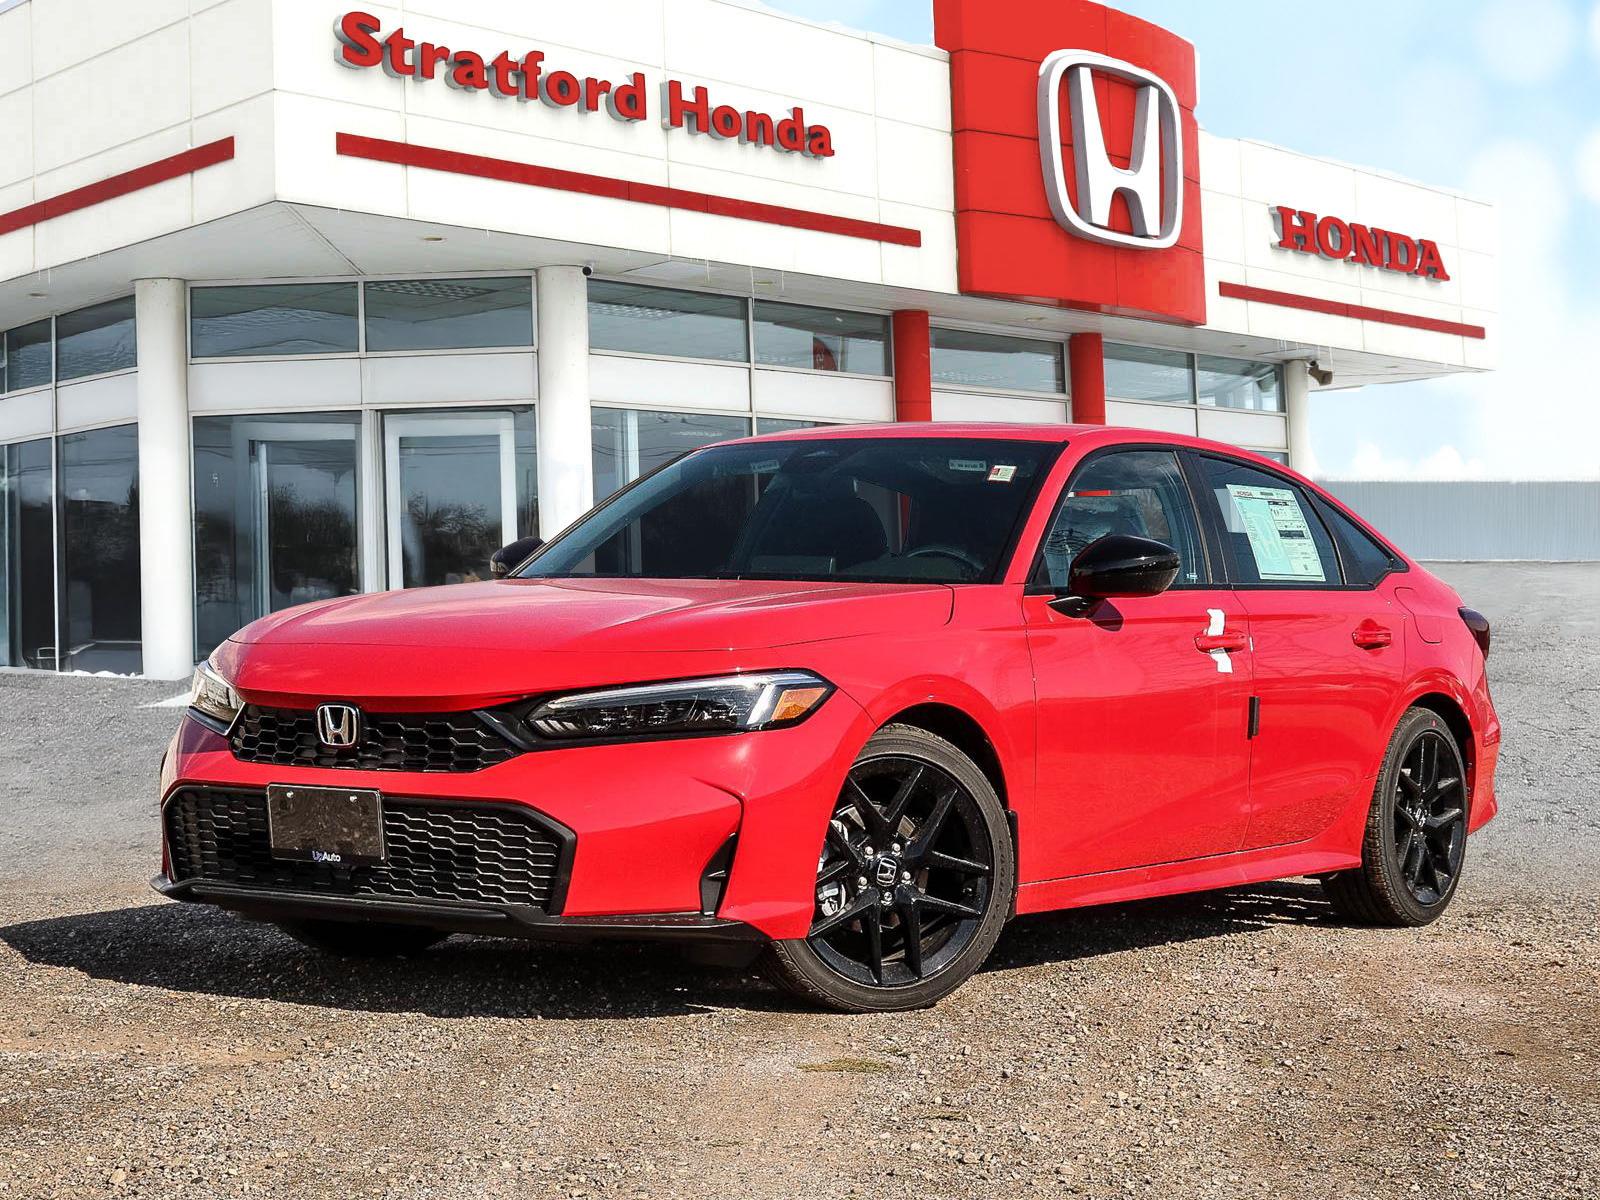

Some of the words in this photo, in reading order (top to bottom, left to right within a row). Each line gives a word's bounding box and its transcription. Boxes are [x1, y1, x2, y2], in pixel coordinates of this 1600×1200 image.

[335, 11, 647, 122] Stratford
[662, 79, 835, 159] Honda
[1270, 205, 1450, 282] HONDA
